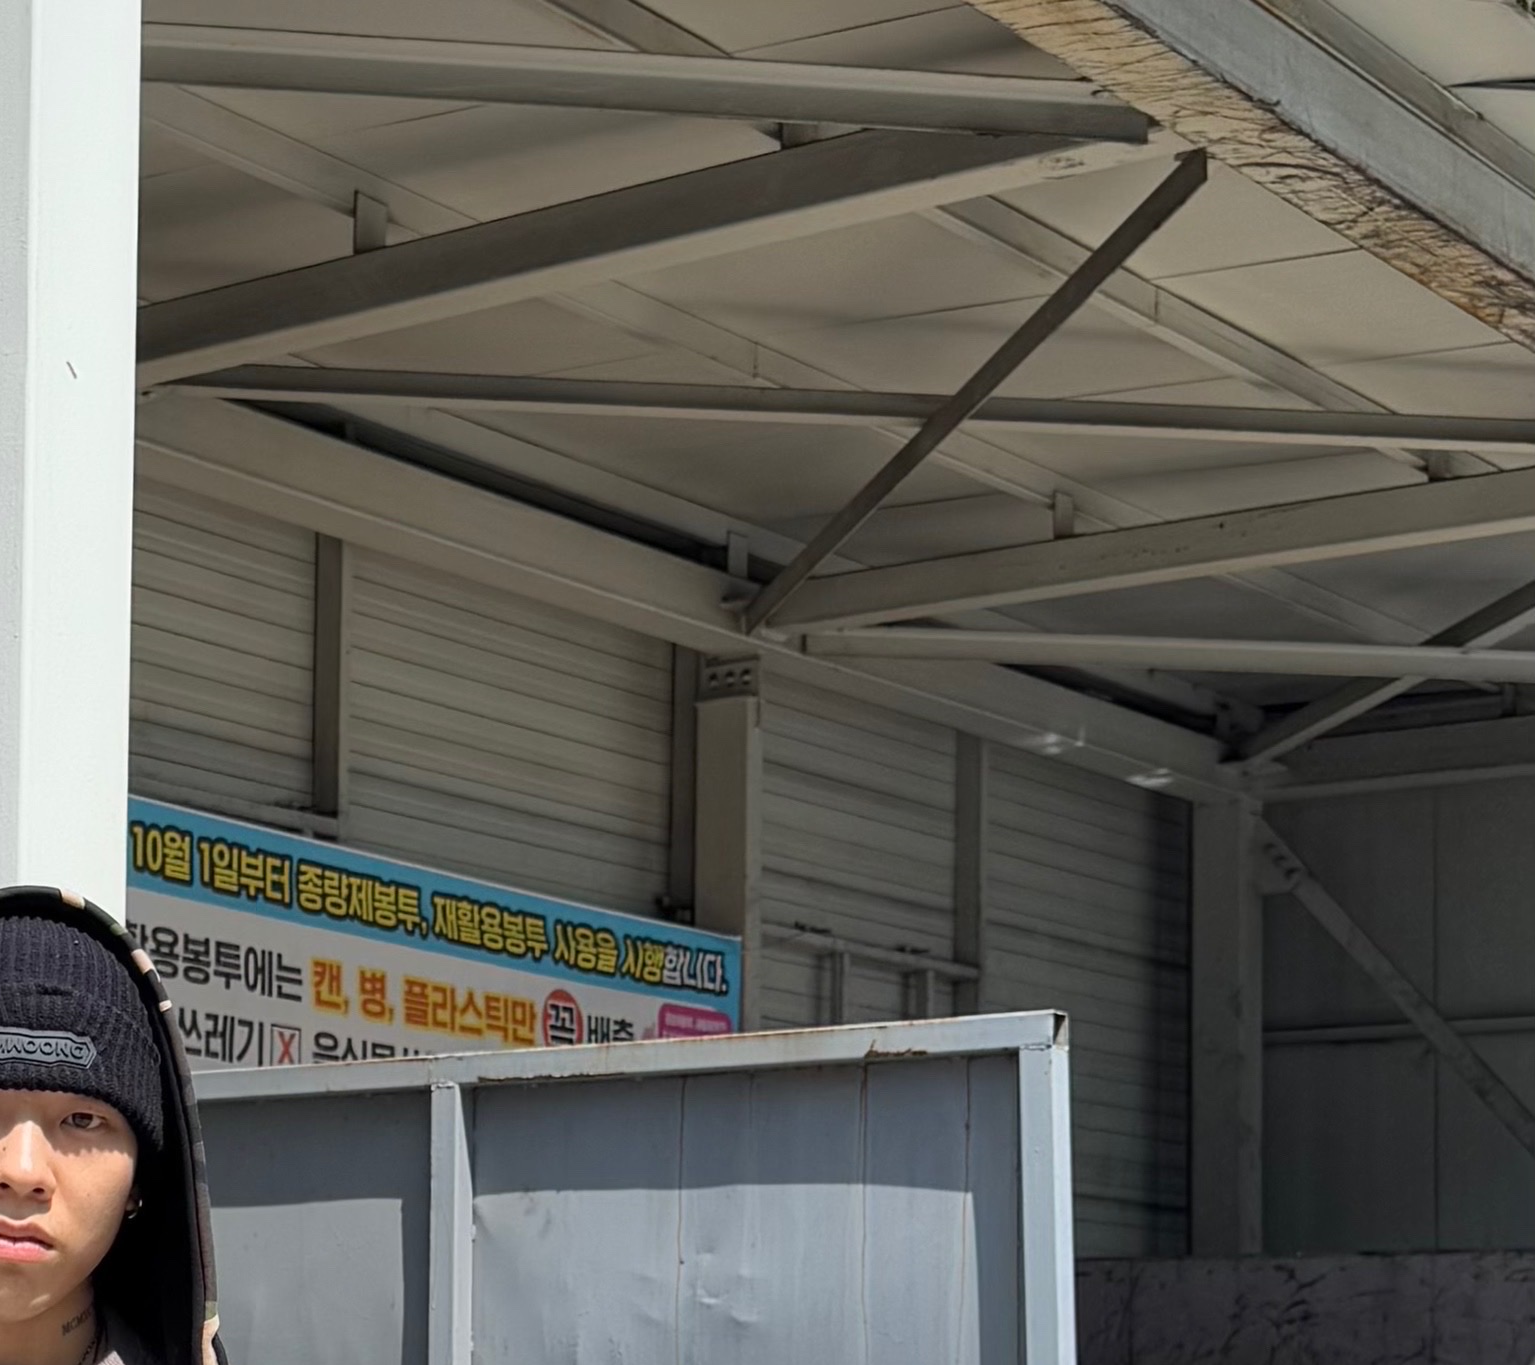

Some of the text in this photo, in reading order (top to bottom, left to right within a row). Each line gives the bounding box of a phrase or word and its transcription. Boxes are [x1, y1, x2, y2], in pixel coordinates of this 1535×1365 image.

[131, 824, 191, 884] 10월
[198, 840, 291, 905] 1일부터
[296, 860, 428, 936] 종량제봉투,
[432, 894, 549, 958] 재활용봉투
[554, 922, 618, 974] 사용을
[621, 935, 728, 993] 시행합니다.
[312, 957, 349, 1014] 캔,
[357, 966, 394, 1024] 병,
[402, 976, 537, 1045] 플라스틱만
